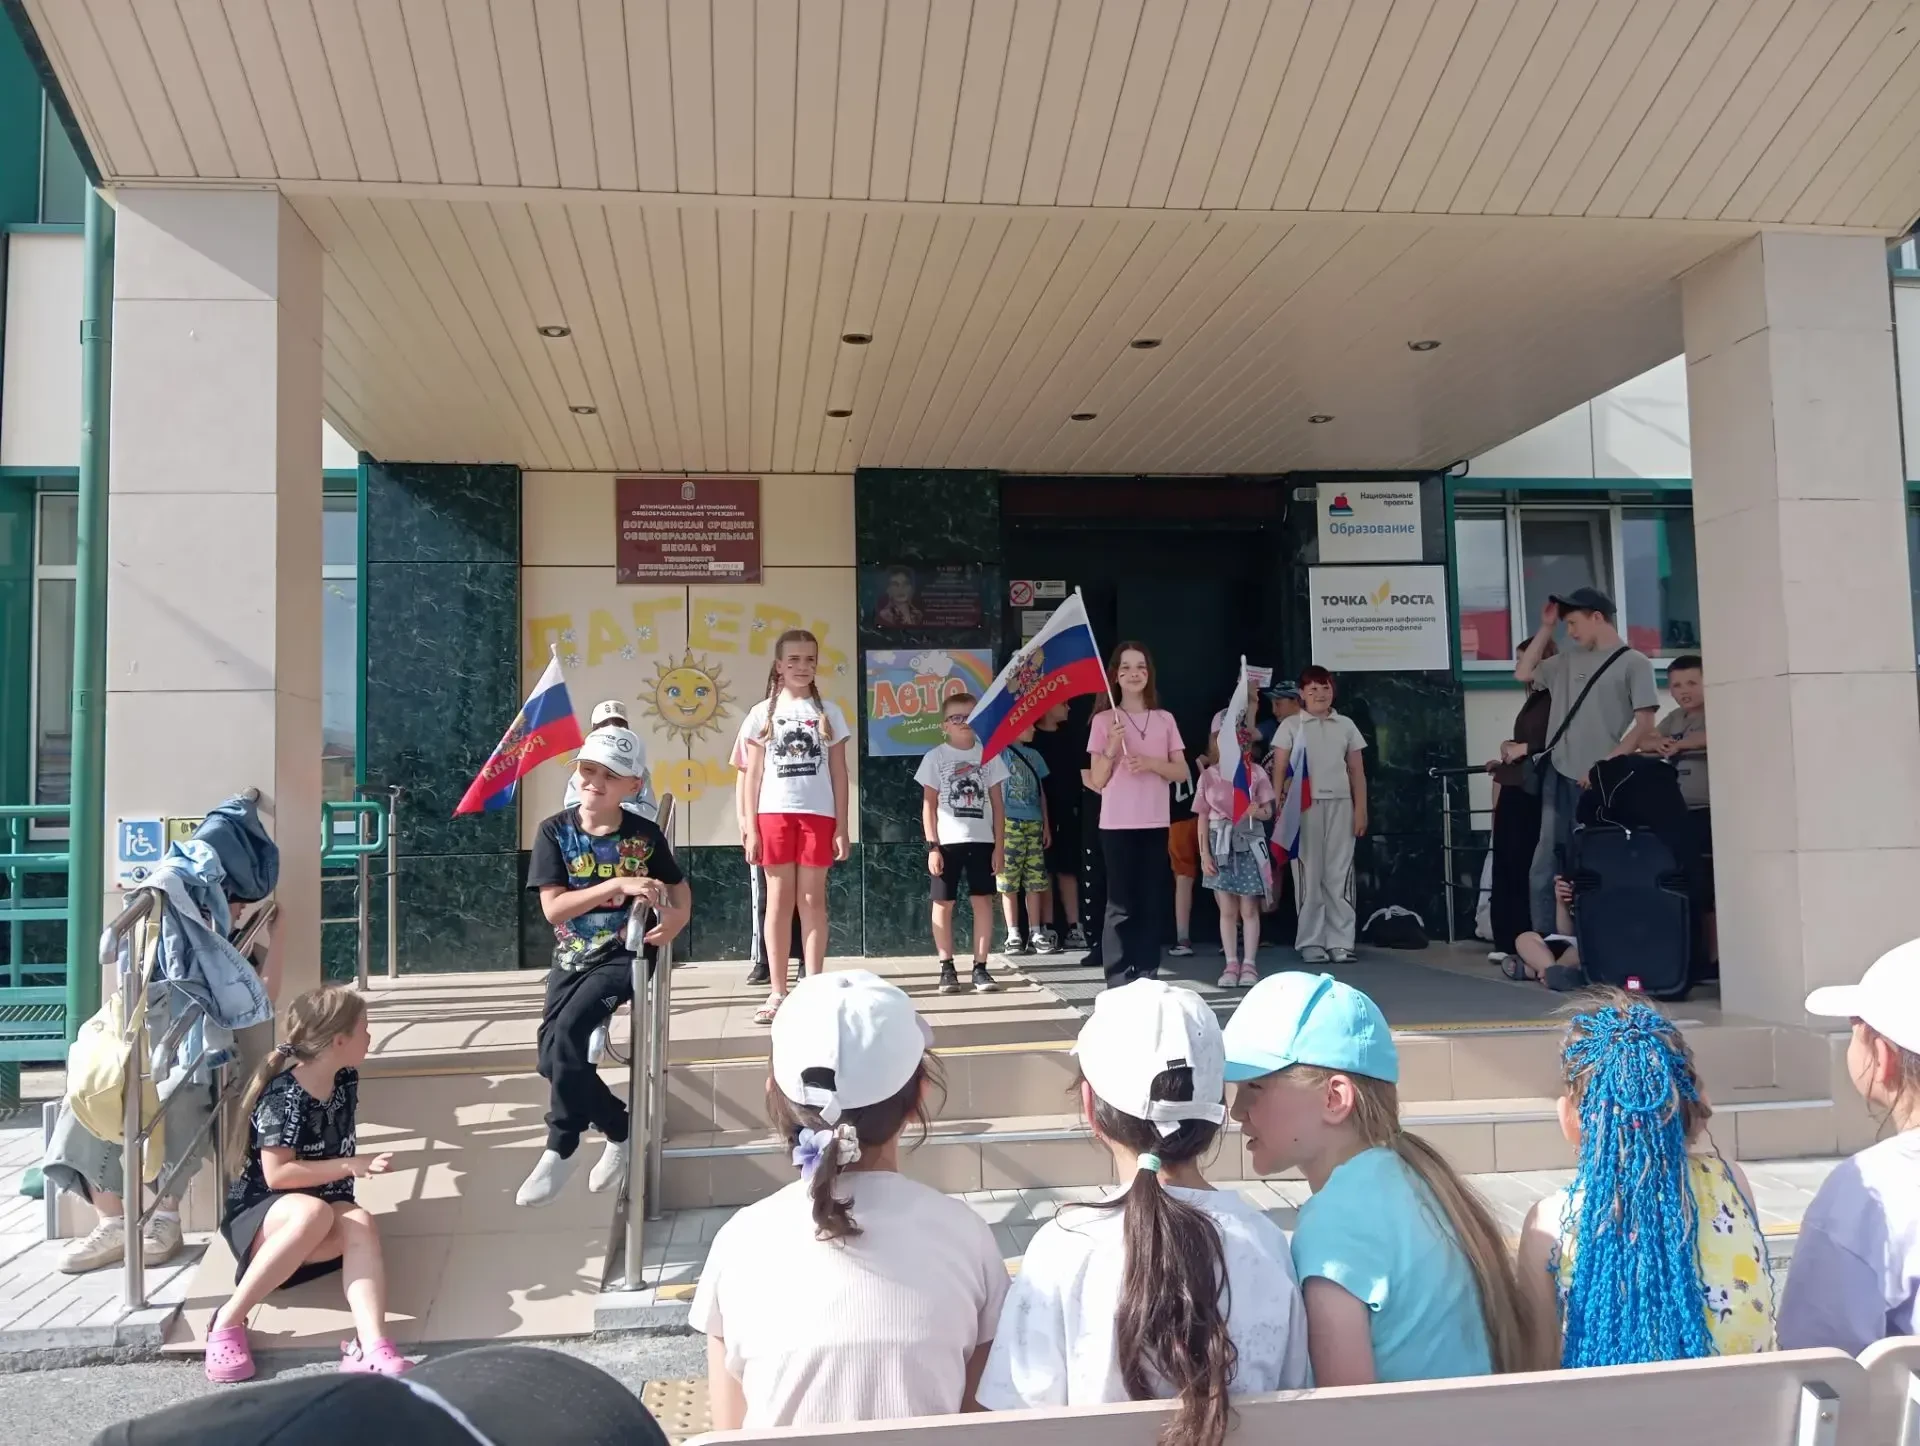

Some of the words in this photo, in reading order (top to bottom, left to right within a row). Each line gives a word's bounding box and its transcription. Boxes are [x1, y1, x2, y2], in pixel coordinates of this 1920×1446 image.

[1360, 492, 1413, 501] Национальные
[623, 520, 704, 530] БОГАНДИНСКАЯ
[707, 520, 755, 530] СРЕДНЯЯ
[1329, 522, 1415, 537] Образование
[623, 532, 754, 541] ОБЩЕОБРАЗОВАТЕЛЬНАЯ
[661, 543, 698, 552] ШКОЛА
[701, 543, 717, 552] №1
[1321, 595, 1368, 606] ТОЧКА
[1391, 594, 1435, 605] РОСТА
[1322, 616, 1345, 624] Центр
[1346, 616, 1394, 624] образования
[1395, 615, 1436, 623] цифрового
[1329, 625, 1383, 633] гуманитарного
[1385, 624, 1422, 632] профилей
